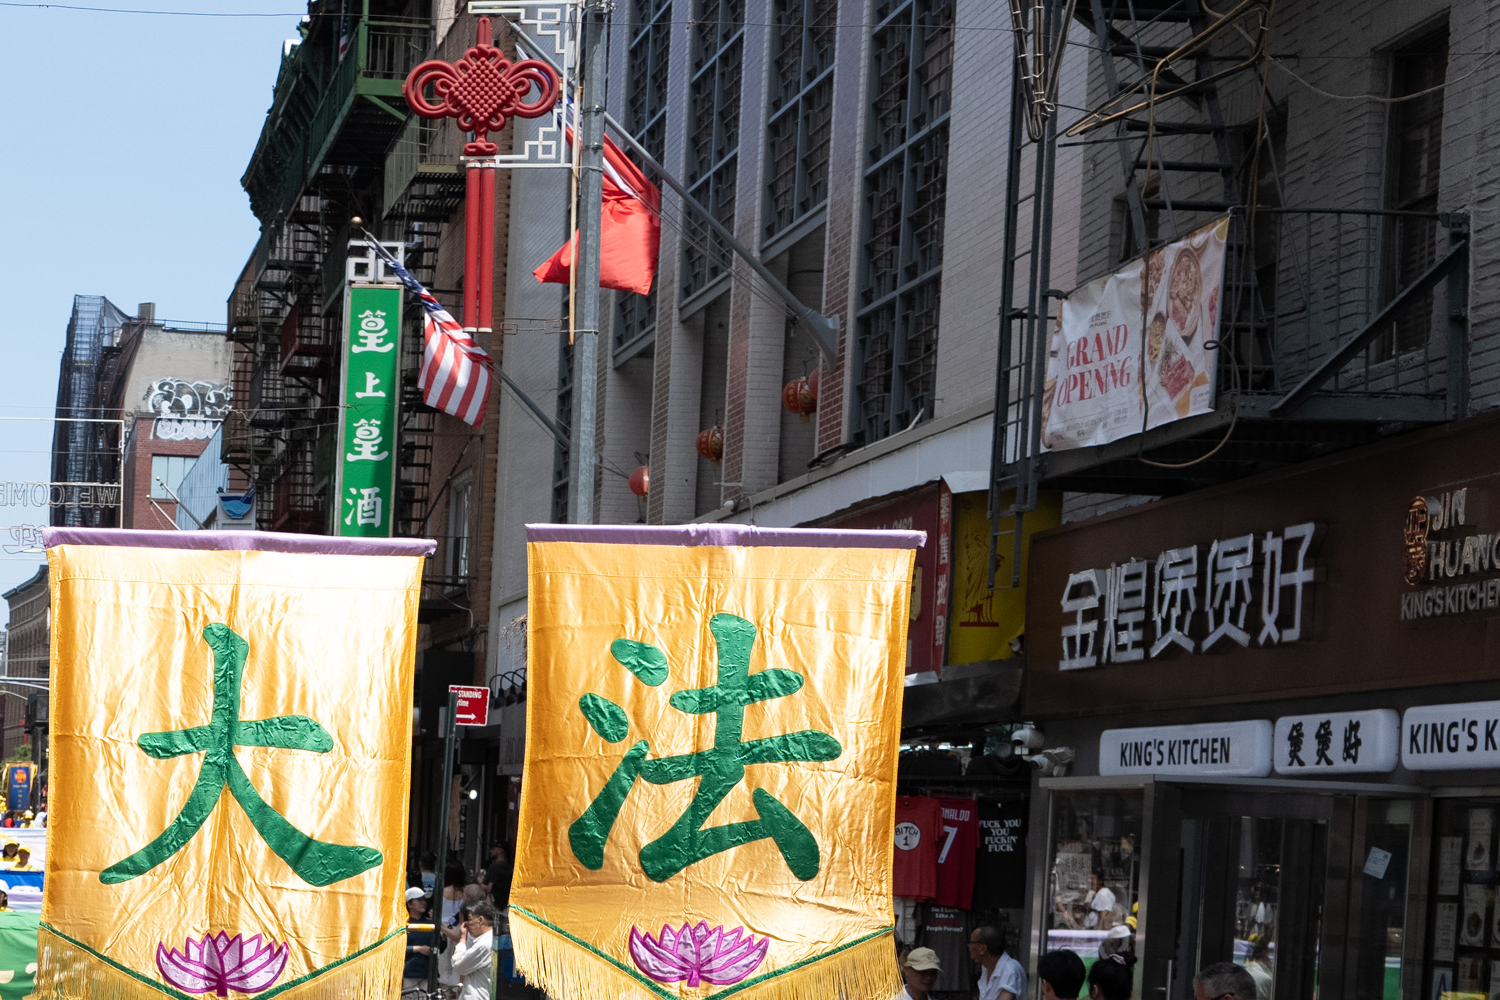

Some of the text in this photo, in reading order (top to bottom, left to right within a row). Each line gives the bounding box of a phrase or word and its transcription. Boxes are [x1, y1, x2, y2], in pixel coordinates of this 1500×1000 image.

[1066, 323, 1128, 371] GRAND
[1056, 355, 1132, 408] OPENING
[1431, 487, 1467, 532] JIN
[1401, 587, 1444, 621] KING'S
[458, 690, 483, 699] STANDING
[569, 615, 841, 882] 法
[1119, 736, 1231, 767] KING'S KITCHEN
[1287, 719, 1362, 767] 煲煲好
[1409, 718, 1479, 754] KING'S
[100, 622, 384, 887] 大
[895, 825, 919, 837] BITCH
[903, 836, 910, 846] 1
[979, 818, 1022, 829] FUCK YOU
[990, 828, 1010, 837] YOU
[937, 825, 958, 864] 7
[987, 844, 1014, 853] FUCK
